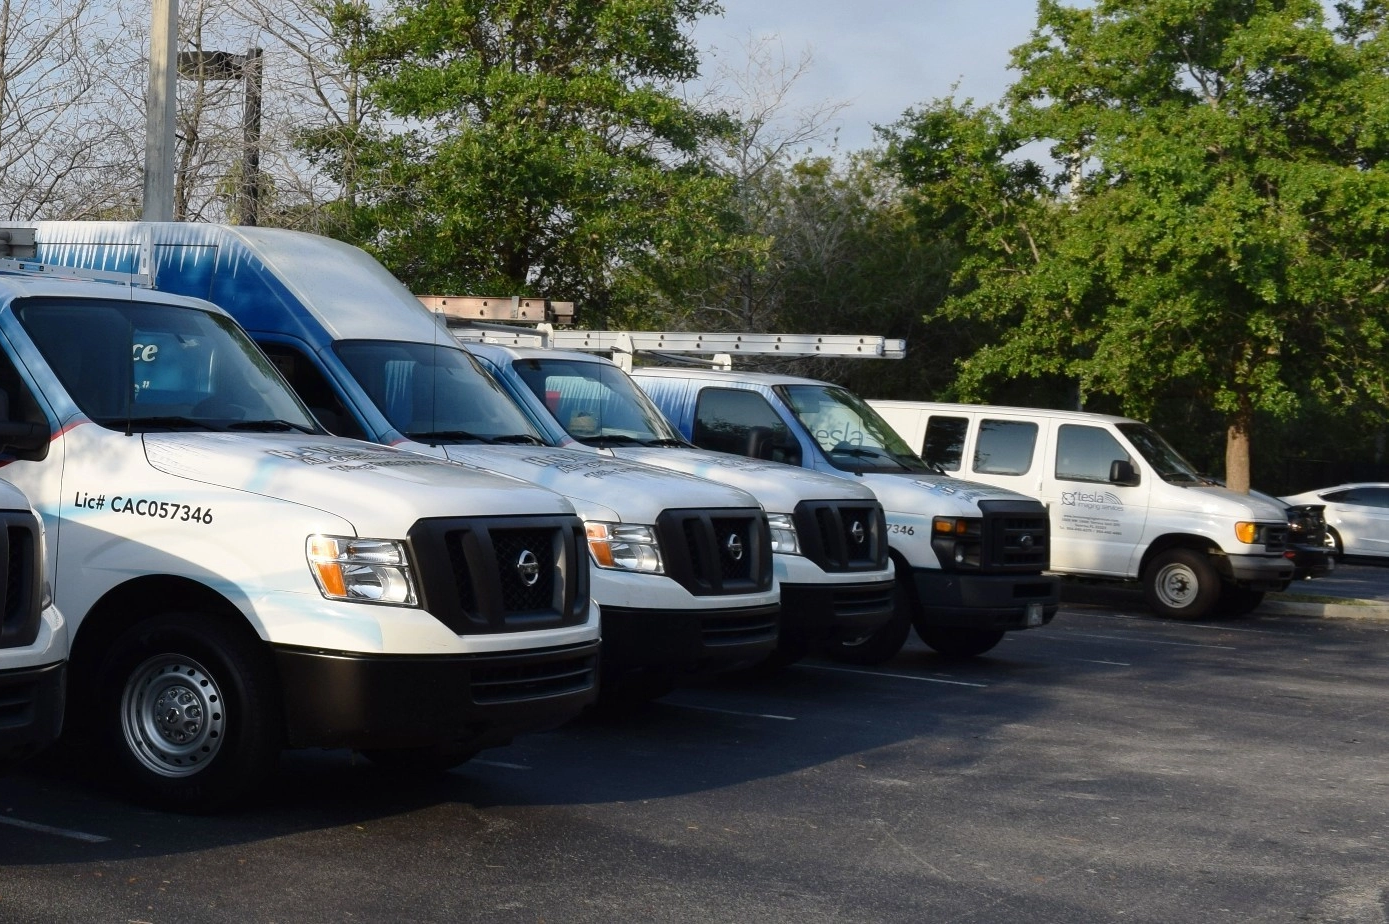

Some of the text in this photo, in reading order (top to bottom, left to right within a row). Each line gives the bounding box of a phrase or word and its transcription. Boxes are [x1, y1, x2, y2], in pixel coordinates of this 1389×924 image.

[74, 491, 213, 525] Lic# CAC057346
[1077, 491, 1104, 504] tesla
